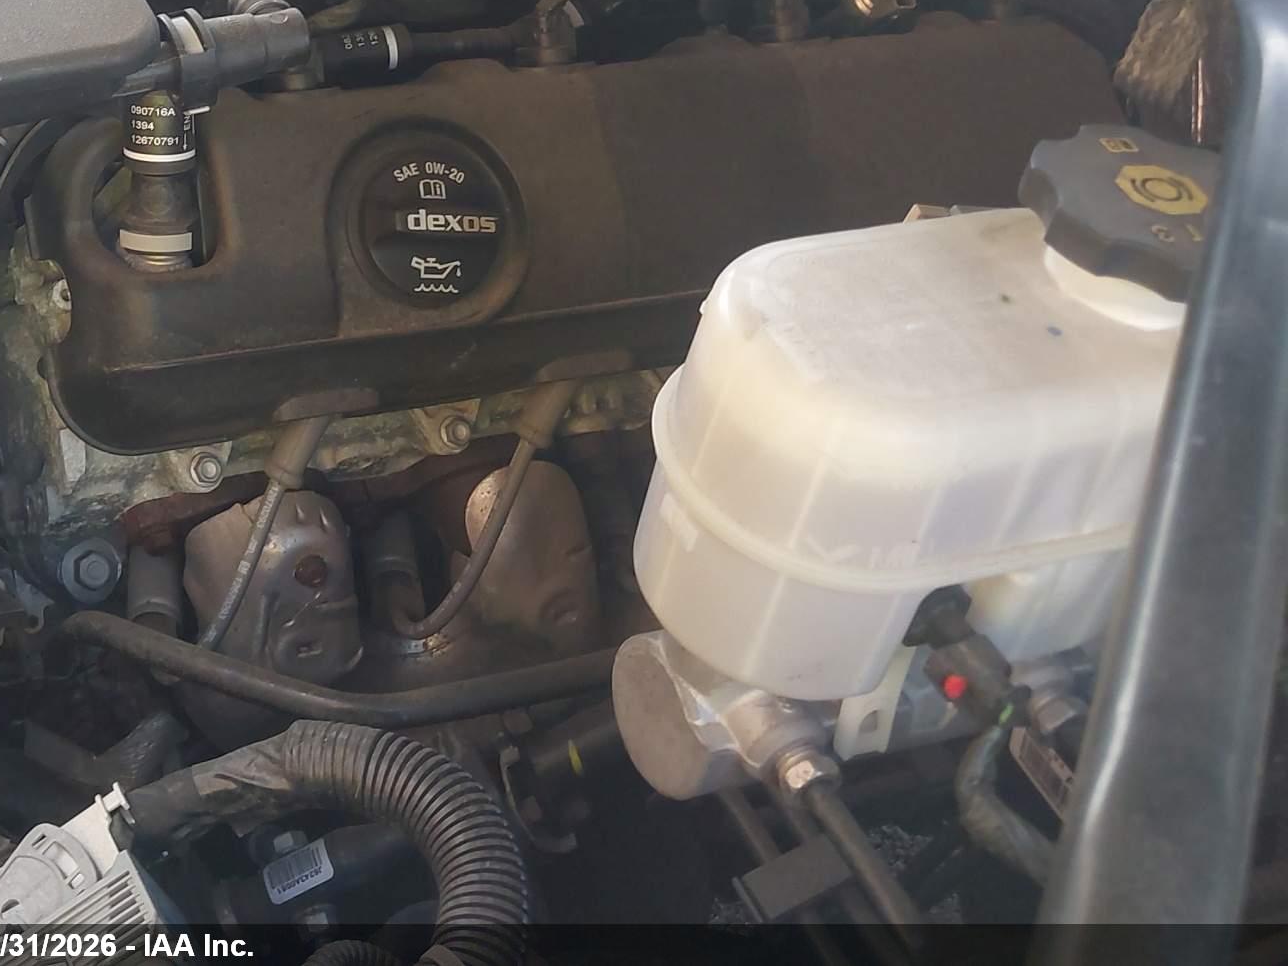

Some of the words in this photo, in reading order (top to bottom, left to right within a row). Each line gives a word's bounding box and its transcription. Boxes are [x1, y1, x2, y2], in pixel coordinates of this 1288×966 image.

[131, 105, 176, 117] 090716A
[132, 119, 155, 131] 1394
[132, 134, 179, 146] 12670791
[393, 162, 420, 182] SAE
[425, 161, 465, 184] 0W-20
[407, 209, 499, 233] dexos
